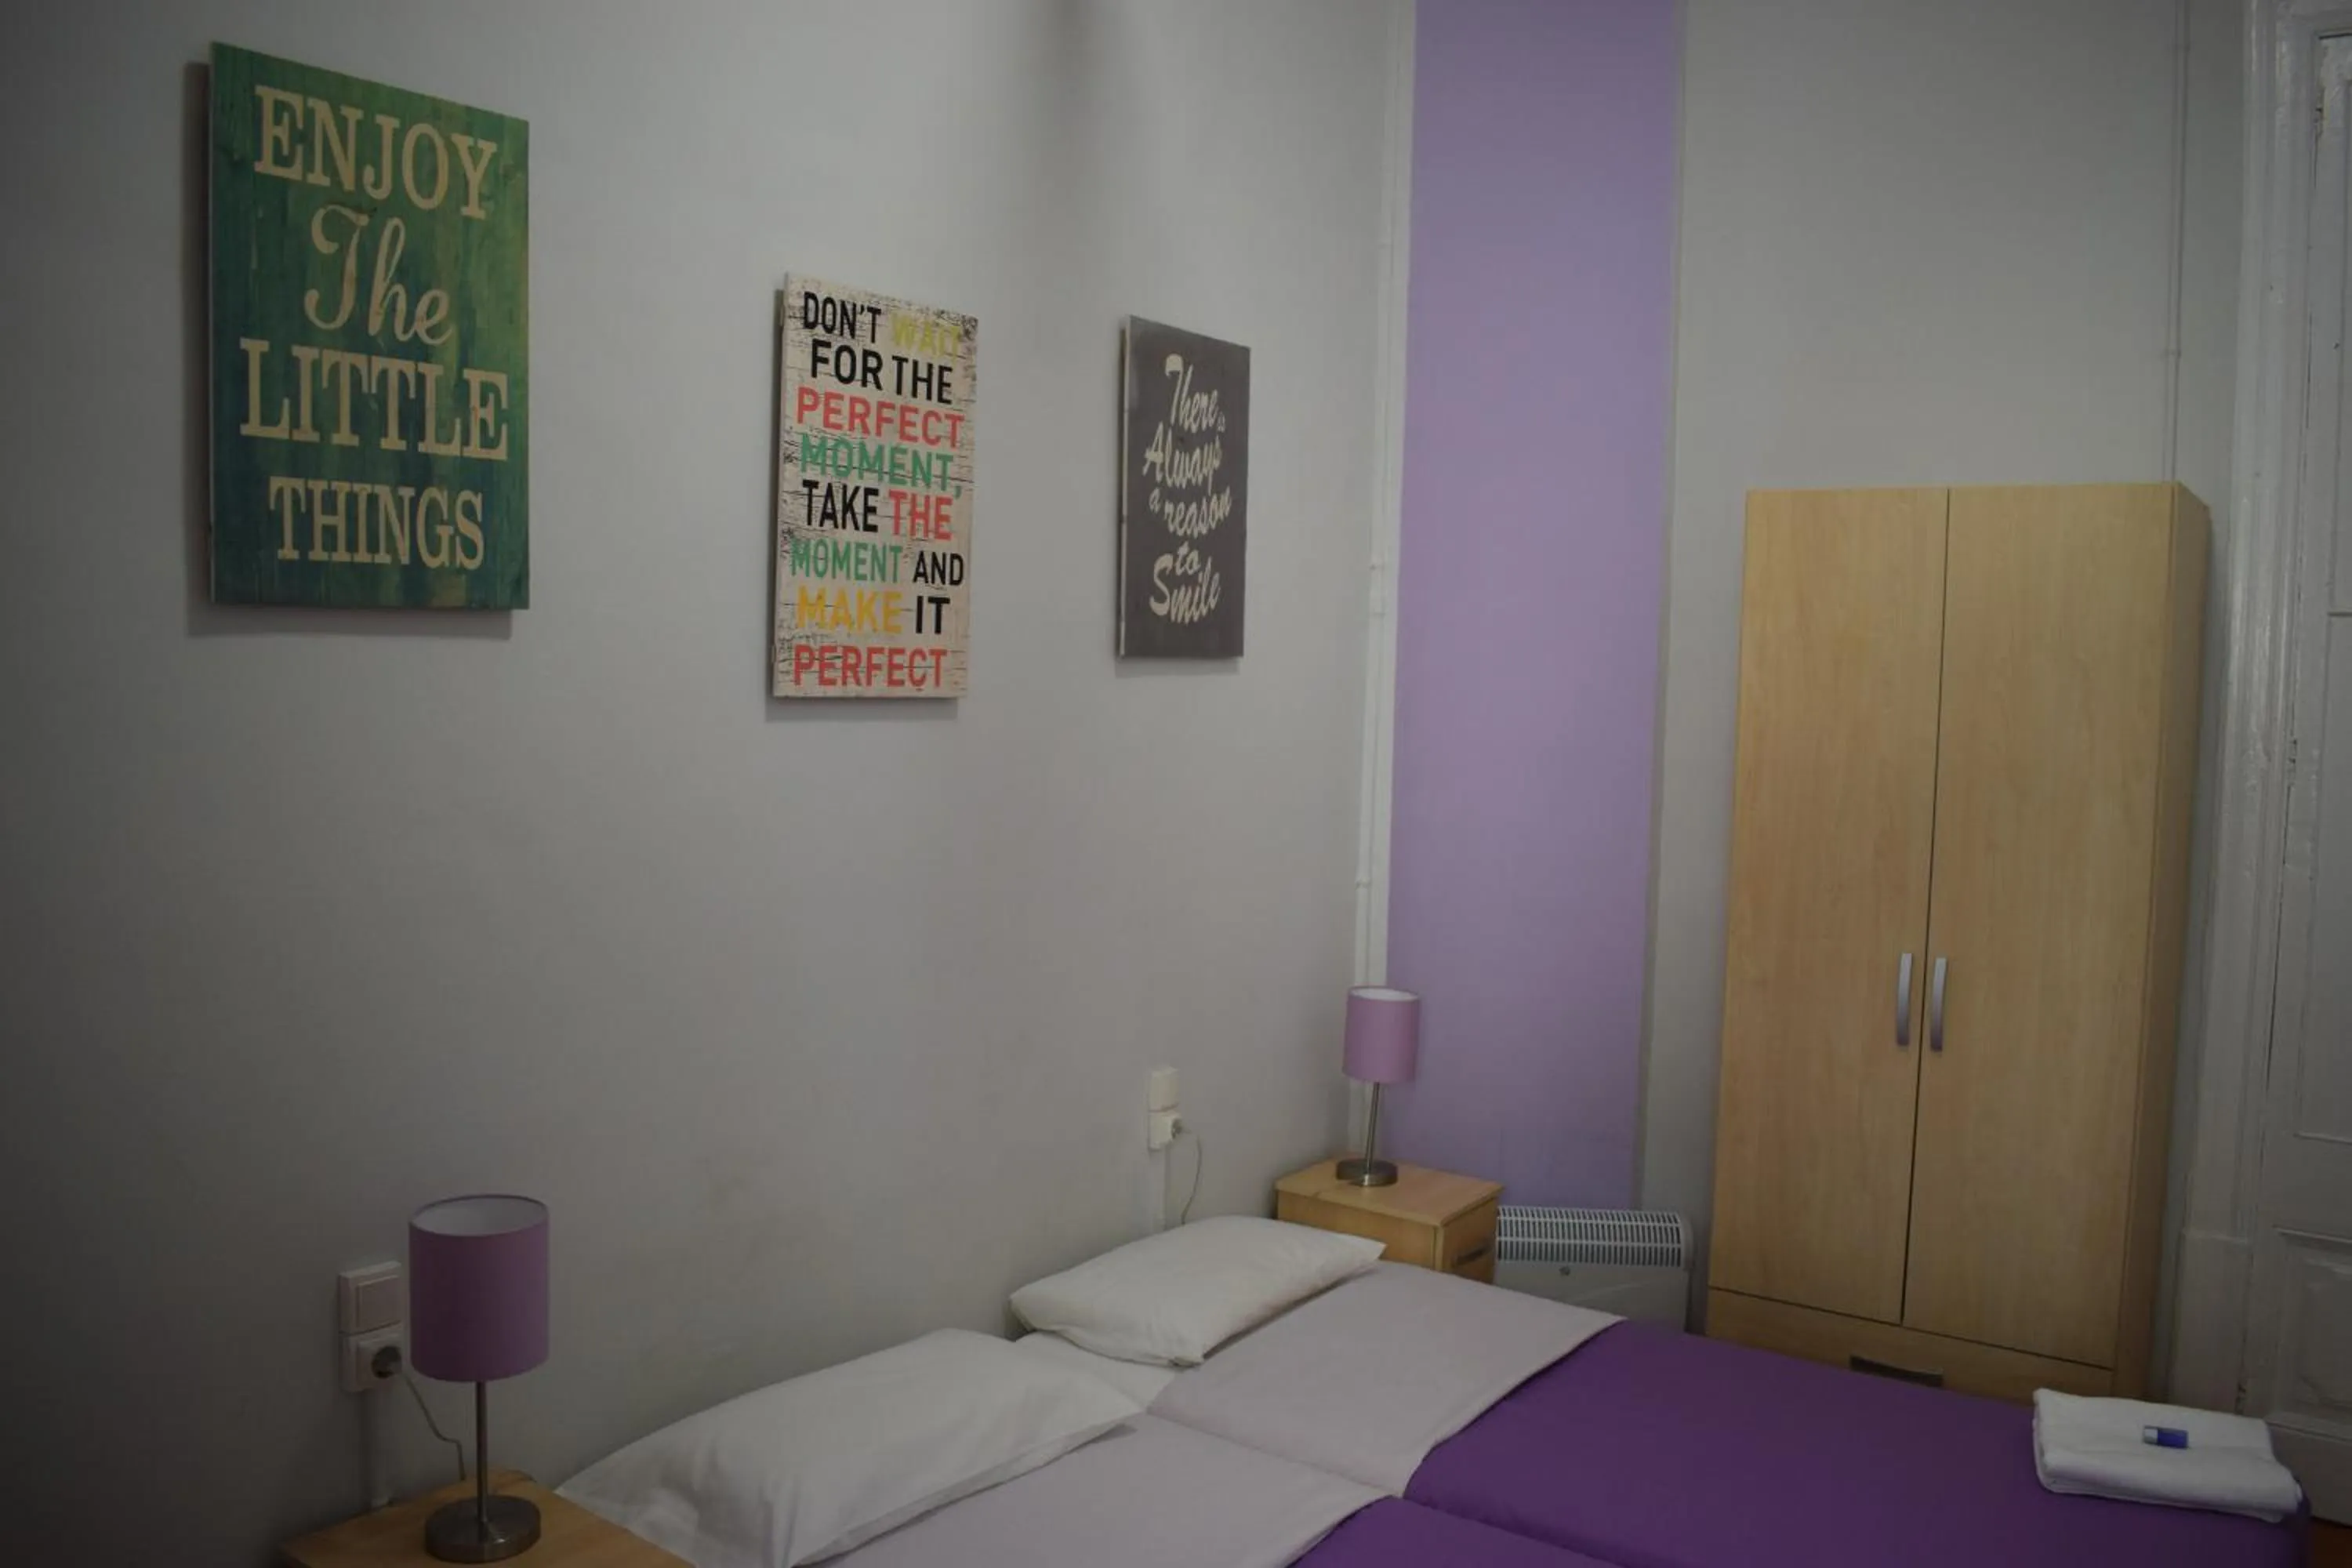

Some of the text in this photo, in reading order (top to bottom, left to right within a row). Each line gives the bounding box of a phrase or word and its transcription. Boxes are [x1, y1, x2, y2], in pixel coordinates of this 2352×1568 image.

[254, 85, 498, 220] ENJOY
[303, 203, 457, 345] The
[803, 291, 881, 343] DON'T
[239, 337, 508, 460] LITTLE
[811, 338, 953, 405] FOR THE
[796, 386, 965, 448] PERFECT
[800, 434, 962, 499] MOMENT,
[1142, 421, 1223, 496] Always
[269, 476, 485, 570] THINGS
[802, 479, 953, 540] TAKE THE
[1163, 485, 1232, 539] reason
[790, 536, 964, 586] MOMENT AND
[1175, 540, 1201, 575] to
[797, 586, 950, 634] MAKE IT
[1149, 552, 1221, 627] Smile
[793, 644, 948, 688] PERFECT
